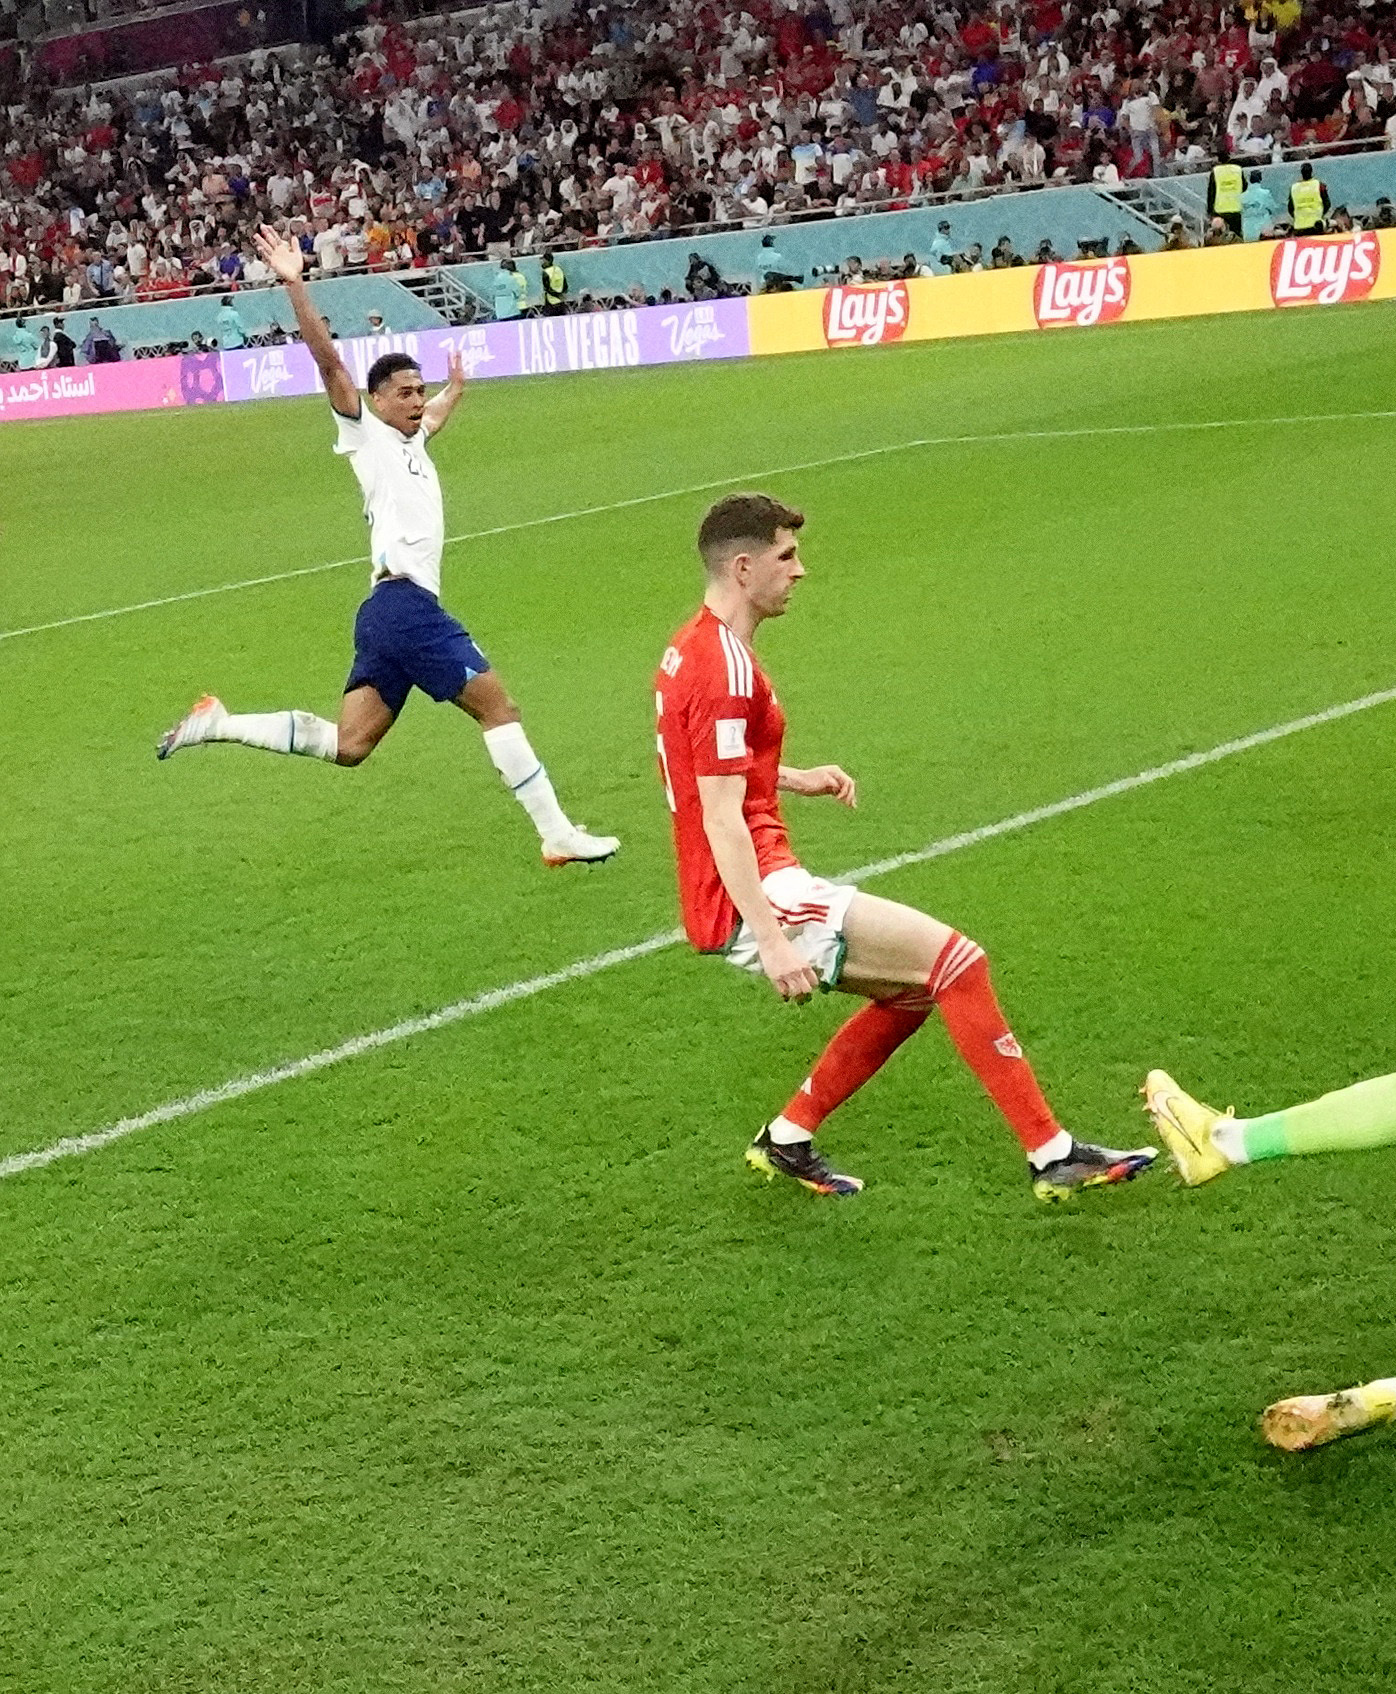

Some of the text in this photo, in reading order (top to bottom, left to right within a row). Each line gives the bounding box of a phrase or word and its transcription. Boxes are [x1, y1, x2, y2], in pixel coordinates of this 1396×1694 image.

[1039, 257, 1127, 326] Lay's
[1275, 232, 1376, 304] Lay's
[518, 311, 640, 375] LAS VEGAS
[828, 281, 906, 345] Lay's
[7, 371, 49, 403] أحمد
[51, 372, 95, 399] استاد
